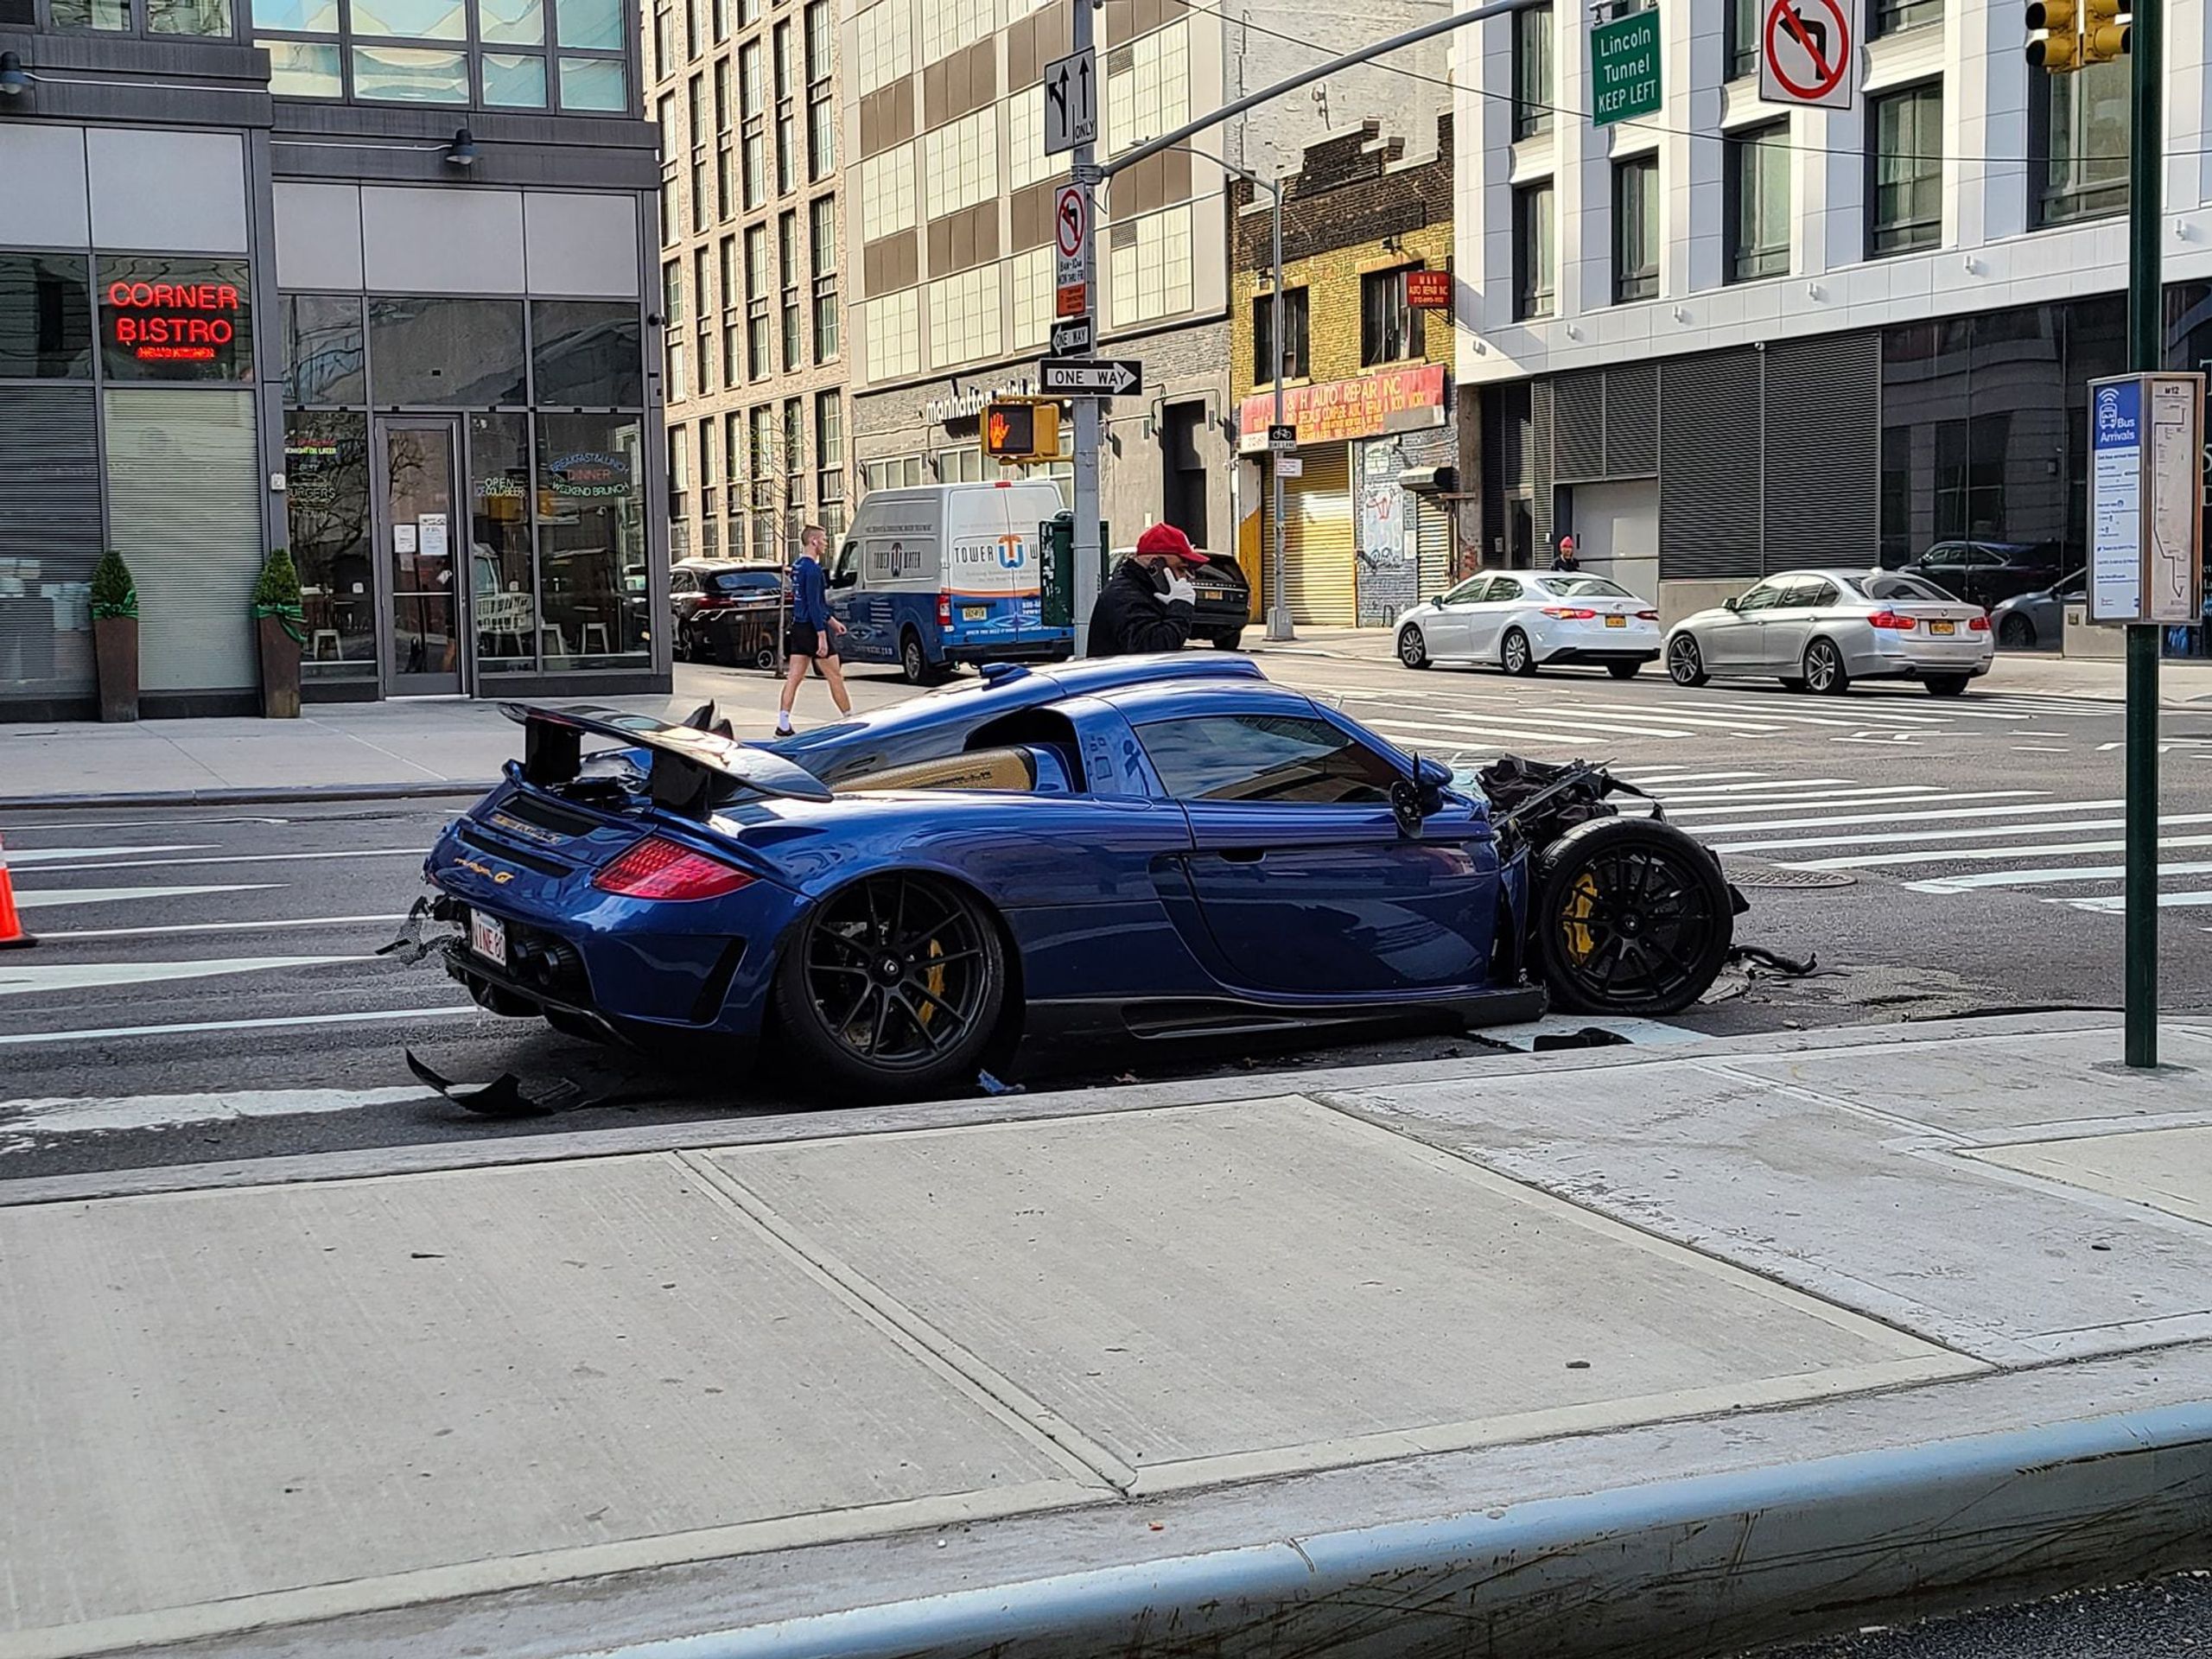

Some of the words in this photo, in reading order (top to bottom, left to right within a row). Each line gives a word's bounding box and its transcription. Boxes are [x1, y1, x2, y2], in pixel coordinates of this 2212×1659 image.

[1600, 26, 1651, 57] Lincoln
[1604, 53, 1649, 84] Tunnel
[1599, 88, 1626, 114] KEEP
[1630, 79, 1656, 105] LEFT
[1076, 119, 1095, 139] ONLY
[110, 282, 238, 310] CORNER
[117, 316, 232, 343] BISTRO
[1055, 332, 1069, 347] ONE
[1072, 328, 1087, 345] WAY
[1055, 370, 1084, 385] ONE
[1097, 371, 1128, 385] WAY
[1300, 391, 1309, 410] H
[1313, 385, 1338, 407] AUTO
[2117, 417, 2135, 429] Bus
[2101, 430, 2135, 443] Arrivals
[485, 477, 515, 488] OPEN
[567, 469, 610, 481] DINNER
[552, 480, 592, 497] WEEKEND
[592, 481, 630, 497] BRUNCH
[955, 545, 994, 563] TOWER
